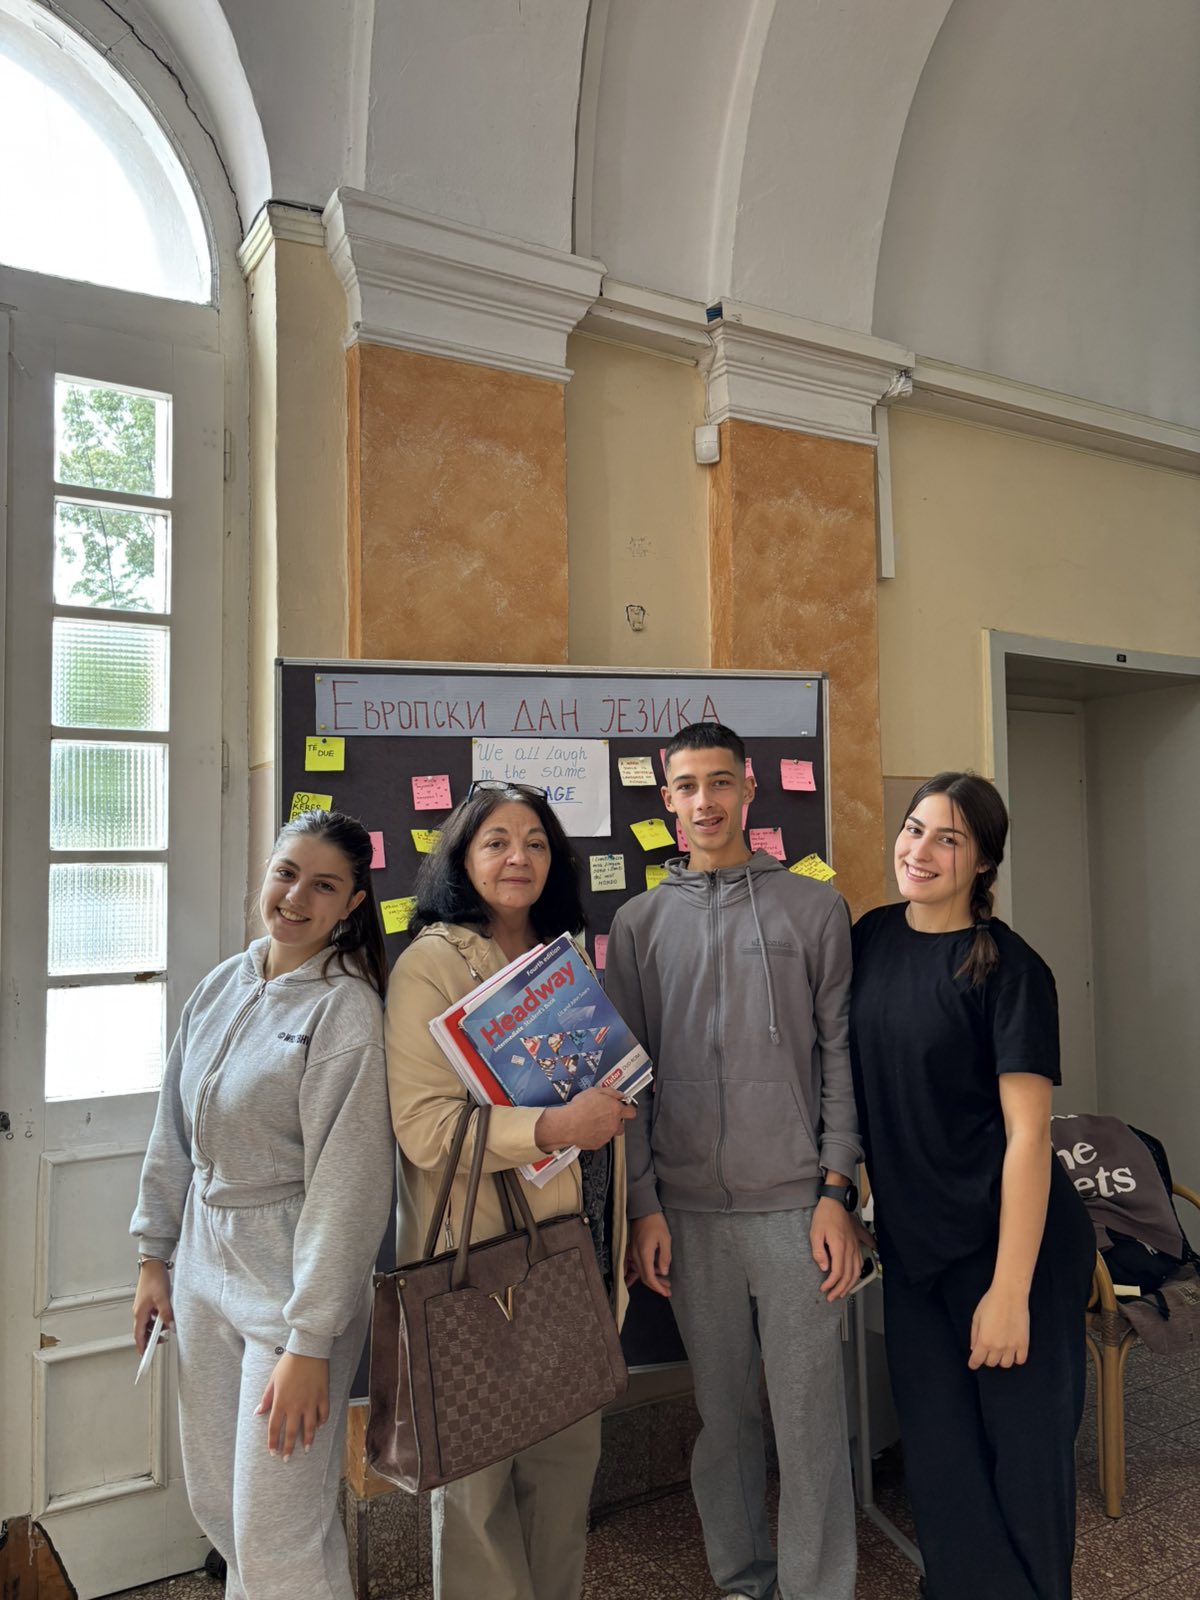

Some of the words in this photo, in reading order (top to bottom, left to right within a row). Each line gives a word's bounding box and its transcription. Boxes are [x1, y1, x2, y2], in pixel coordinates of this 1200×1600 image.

[510, 697, 579, 732] ДАН
[477, 743, 504, 761] We
[481, 765, 494, 780] in
[505, 763, 526, 779] the
[541, 765, 586, 780] same
[295, 793, 310, 804] SO
[526, 959, 544, 977] Fourth
[542, 944, 562, 963] edition
[479, 960, 576, 1046] Headway
[493, 1025, 524, 1053] Intermediate
